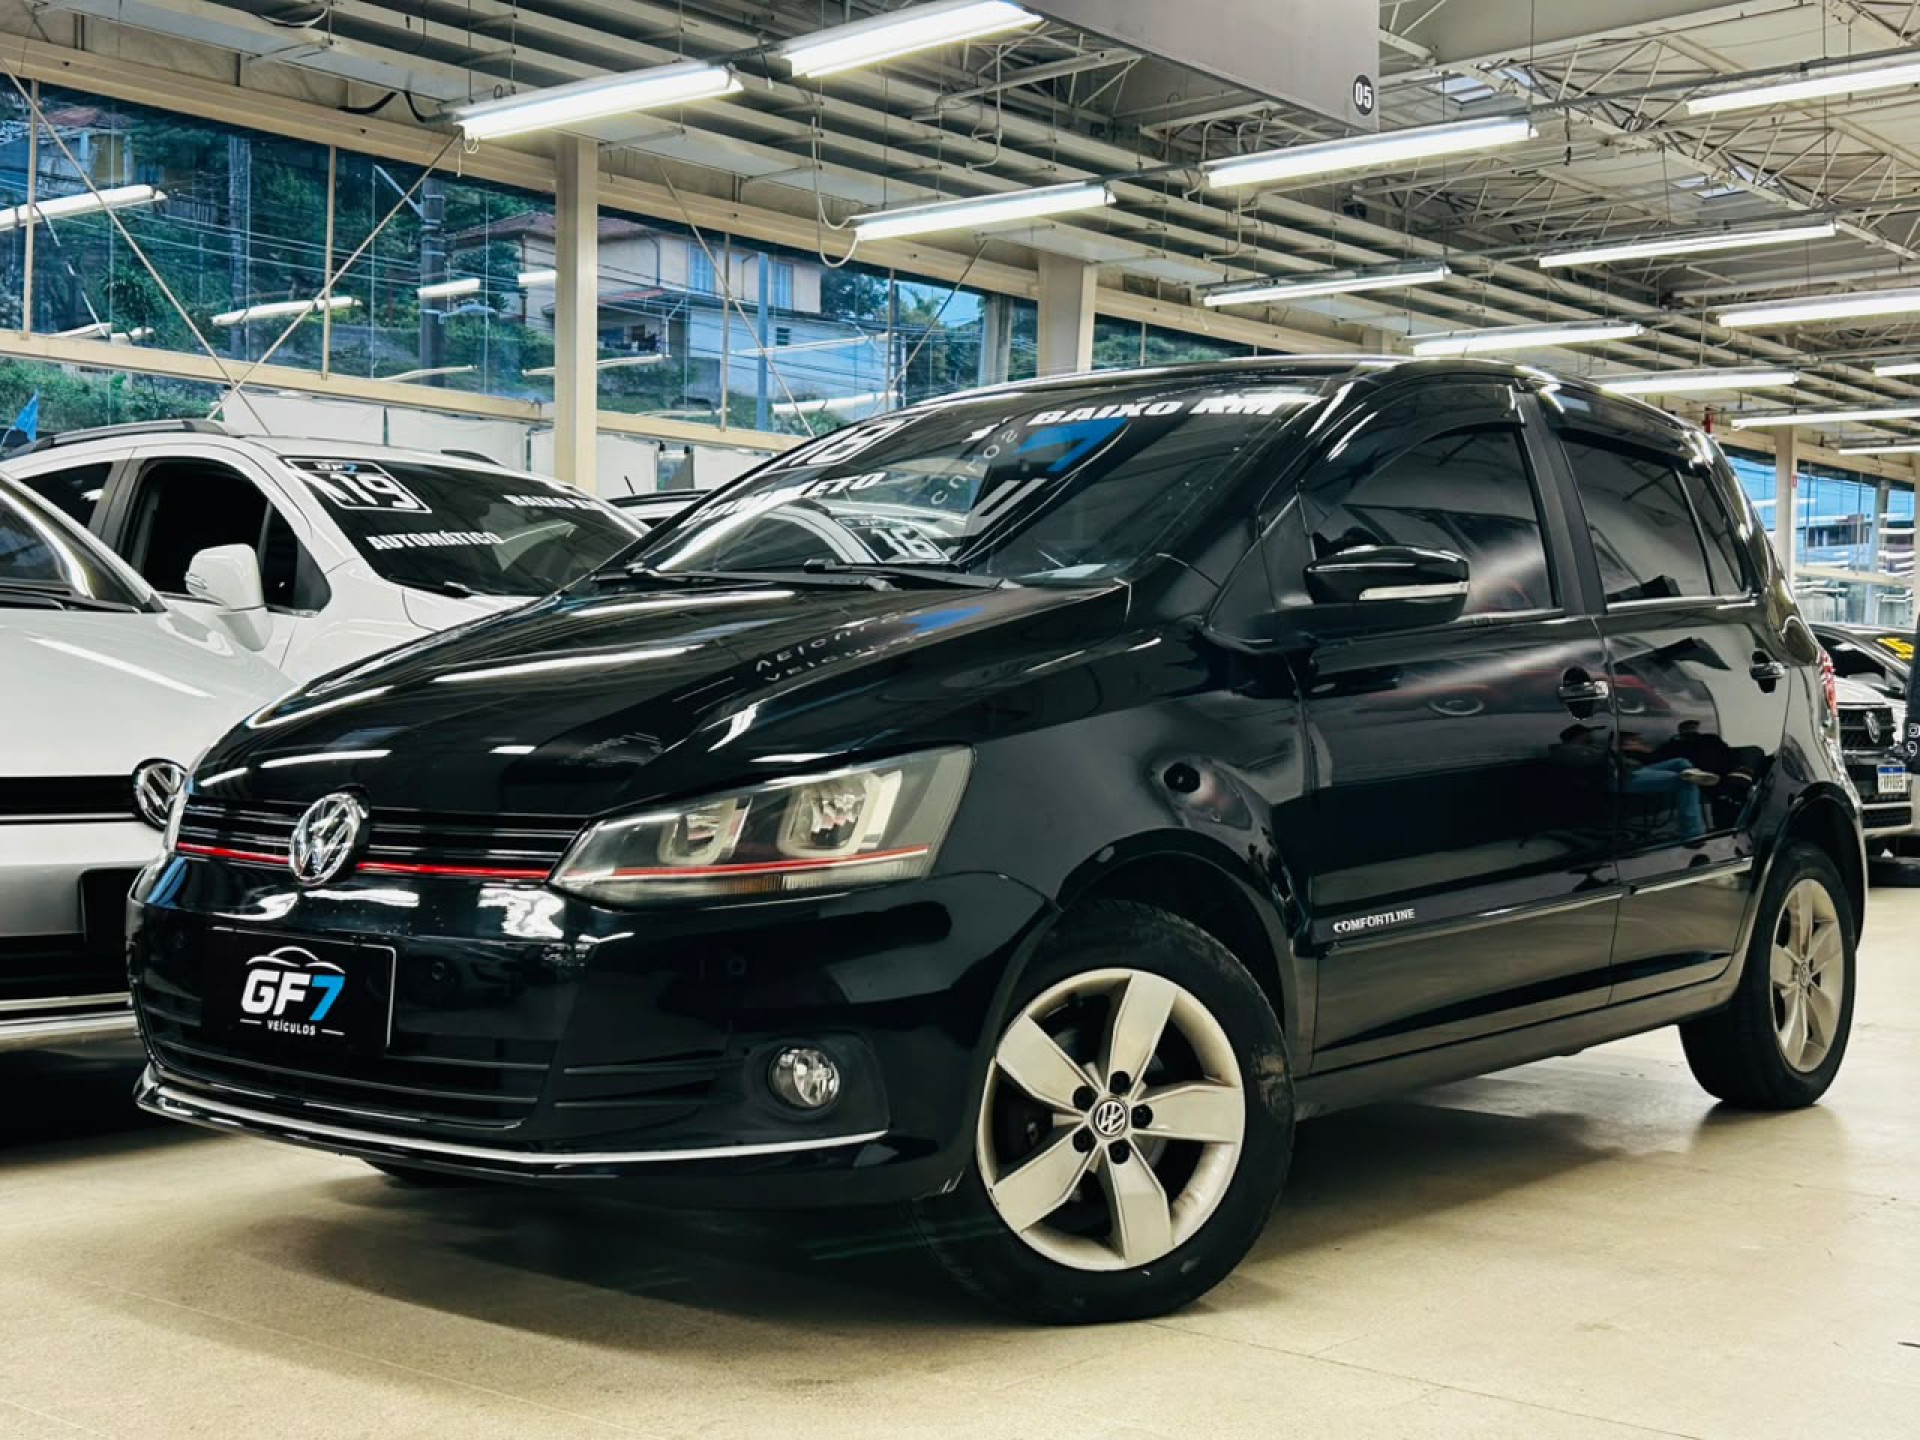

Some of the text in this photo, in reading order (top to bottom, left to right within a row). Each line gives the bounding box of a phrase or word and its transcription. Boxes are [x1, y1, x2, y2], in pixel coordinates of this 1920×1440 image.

[1355, 81, 1372, 109] 05
[1026, 395, 1286, 426] BAIXO KM
[366, 530, 504, 550] AUTOMÁTICO
[1333, 908, 1416, 934] COMFORTLINE
[241, 968, 346, 1021] GF7
[266, 1019, 316, 1036] VEÍCULOS
